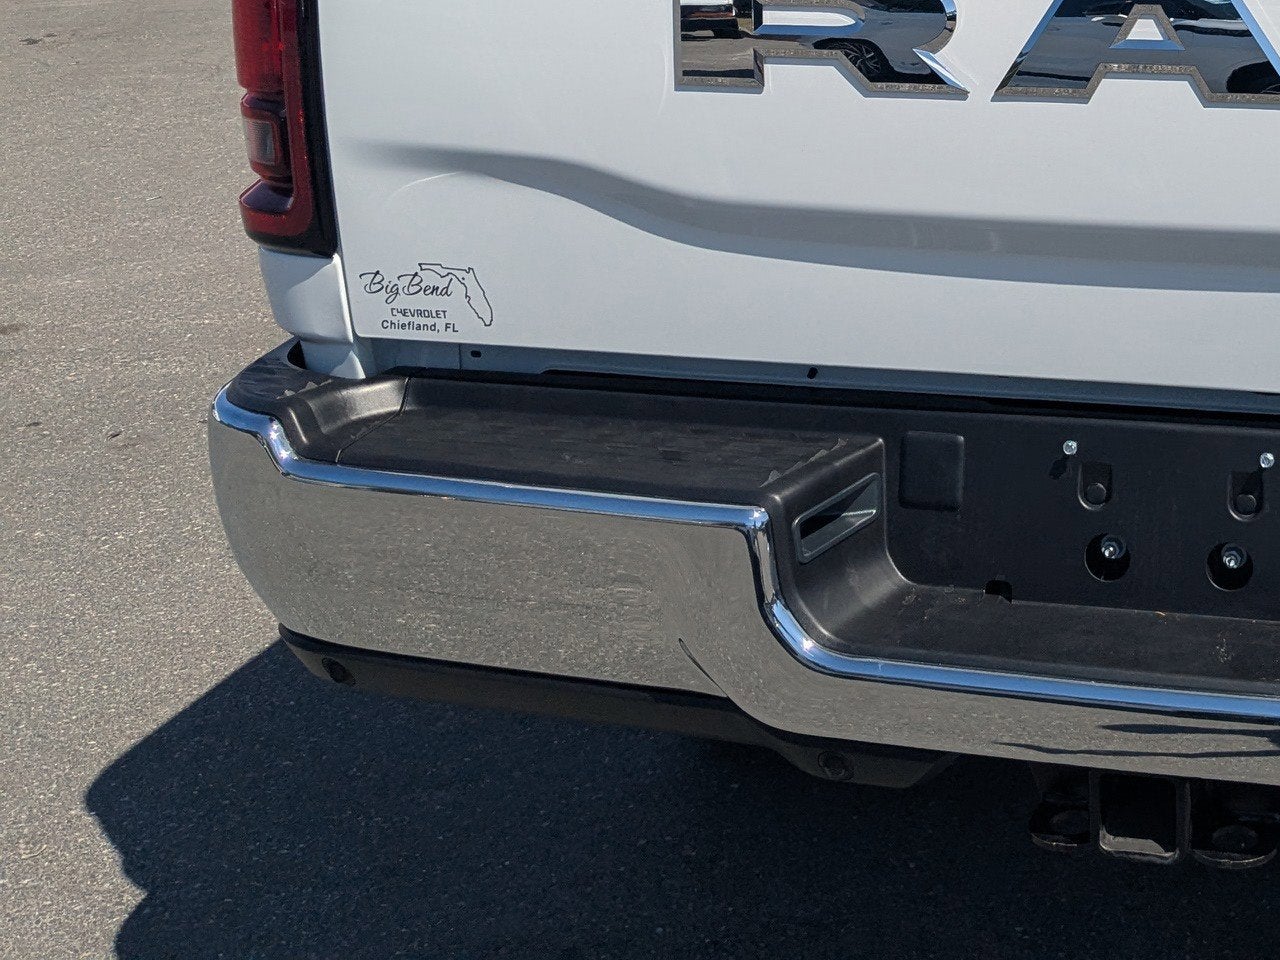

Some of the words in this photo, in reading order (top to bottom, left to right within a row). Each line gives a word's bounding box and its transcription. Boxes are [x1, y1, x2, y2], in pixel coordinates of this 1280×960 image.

[359, 270, 401, 304] Big
[397, 271, 454, 297] Bend
[390, 307, 448, 319] CHEVROLET
[381, 319, 440, 333] Chiefland,
[444, 322, 459, 333] FL
